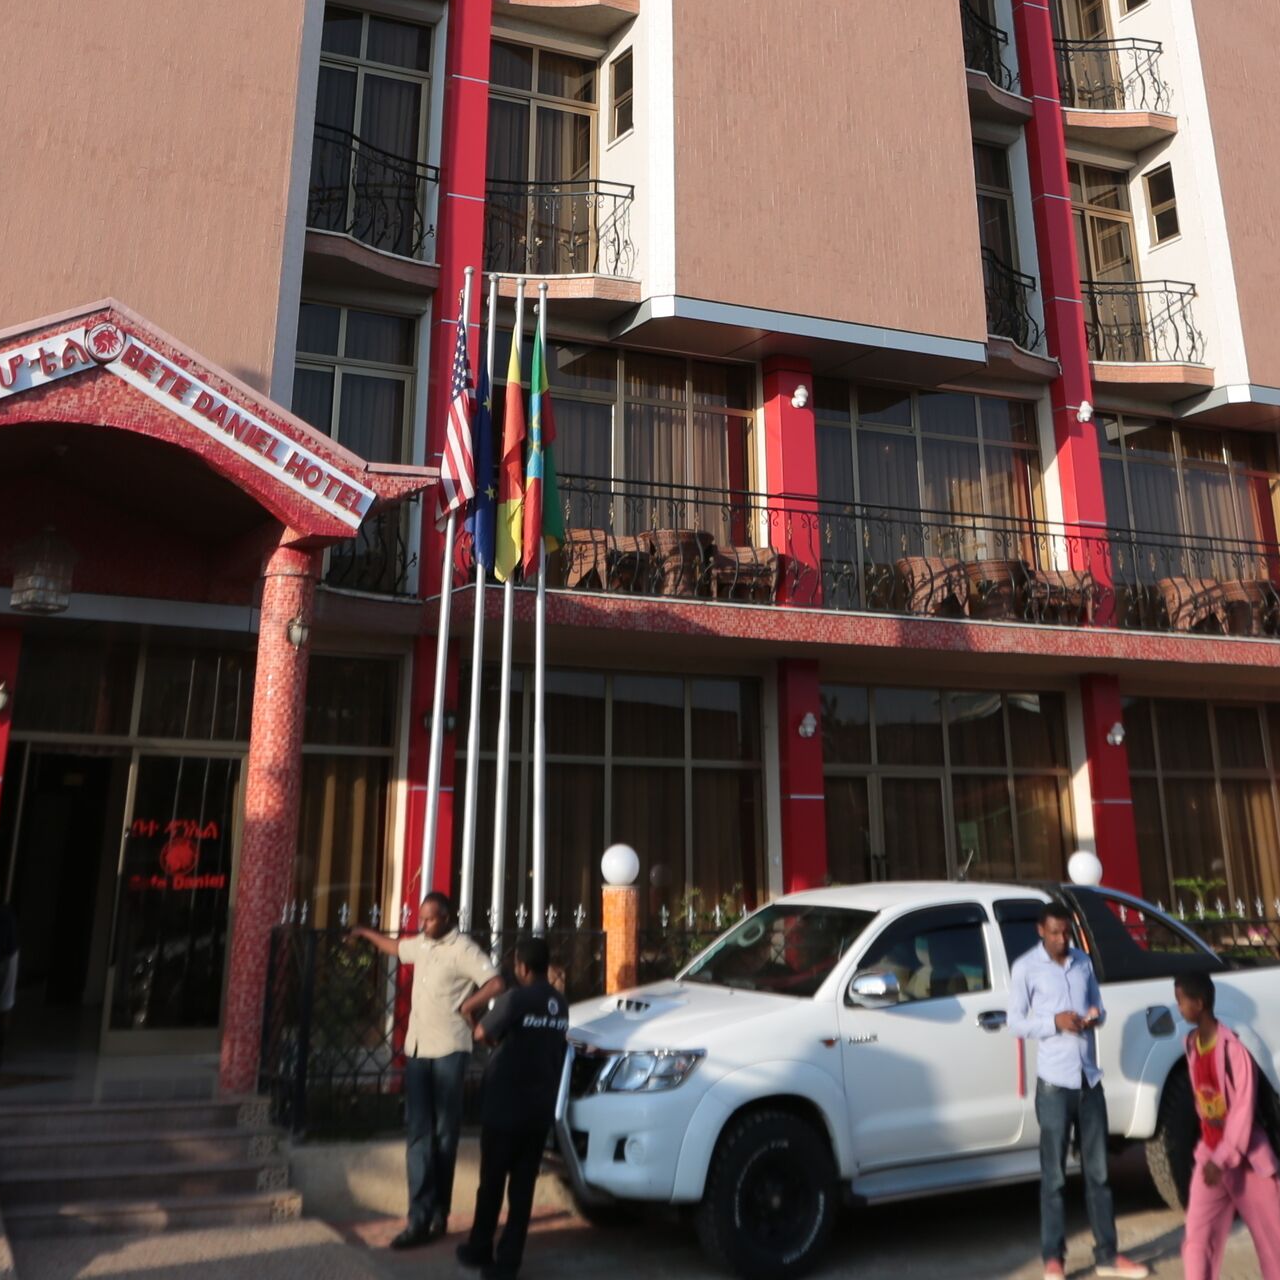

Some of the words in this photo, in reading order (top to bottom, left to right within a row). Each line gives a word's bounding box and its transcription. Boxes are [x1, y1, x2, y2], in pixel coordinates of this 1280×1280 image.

[120, 343, 192, 402] BETE
[192, 390, 279, 464] DANIEL
[283, 450, 364, 518] HOTEL
